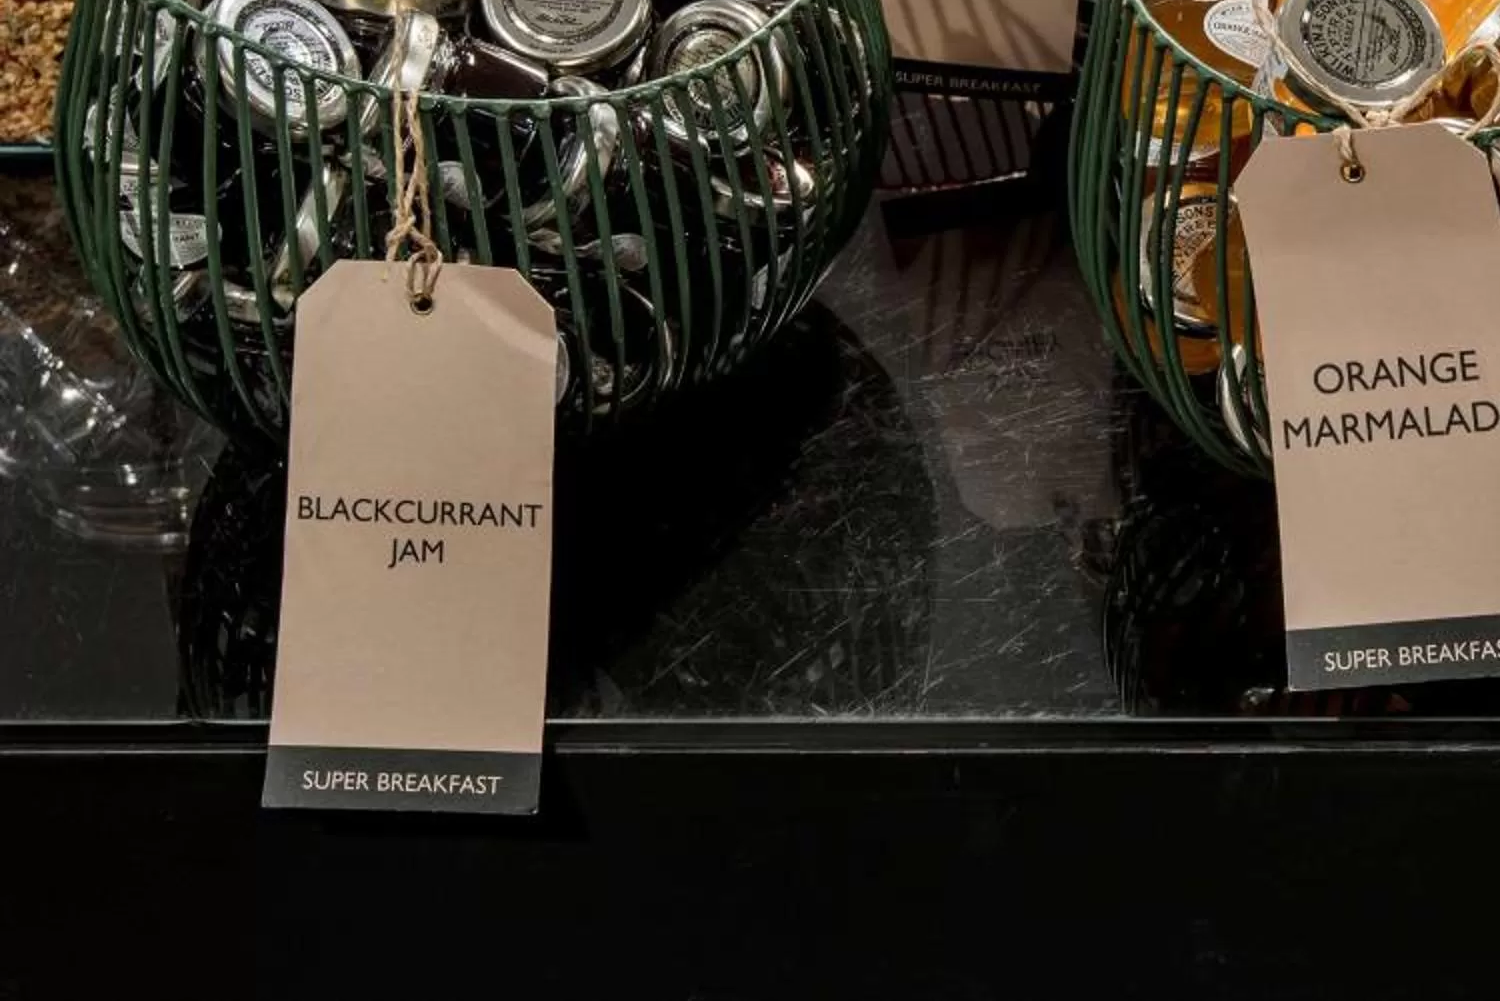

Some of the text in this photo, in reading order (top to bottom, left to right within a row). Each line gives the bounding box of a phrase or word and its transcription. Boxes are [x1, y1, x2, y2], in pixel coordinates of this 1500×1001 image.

[1327, 5, 1357, 60] TIPTREE
[1311, 33, 1355, 77] WILKIN
[1313, 350, 1480, 394] ORANGE
[297, 495, 542, 528] BLACKCURRANT
[388, 538, 444, 568] JAM
[1324, 649, 1393, 672] SUPER
[302, 770, 503, 795] SUPER BREAKFAST
